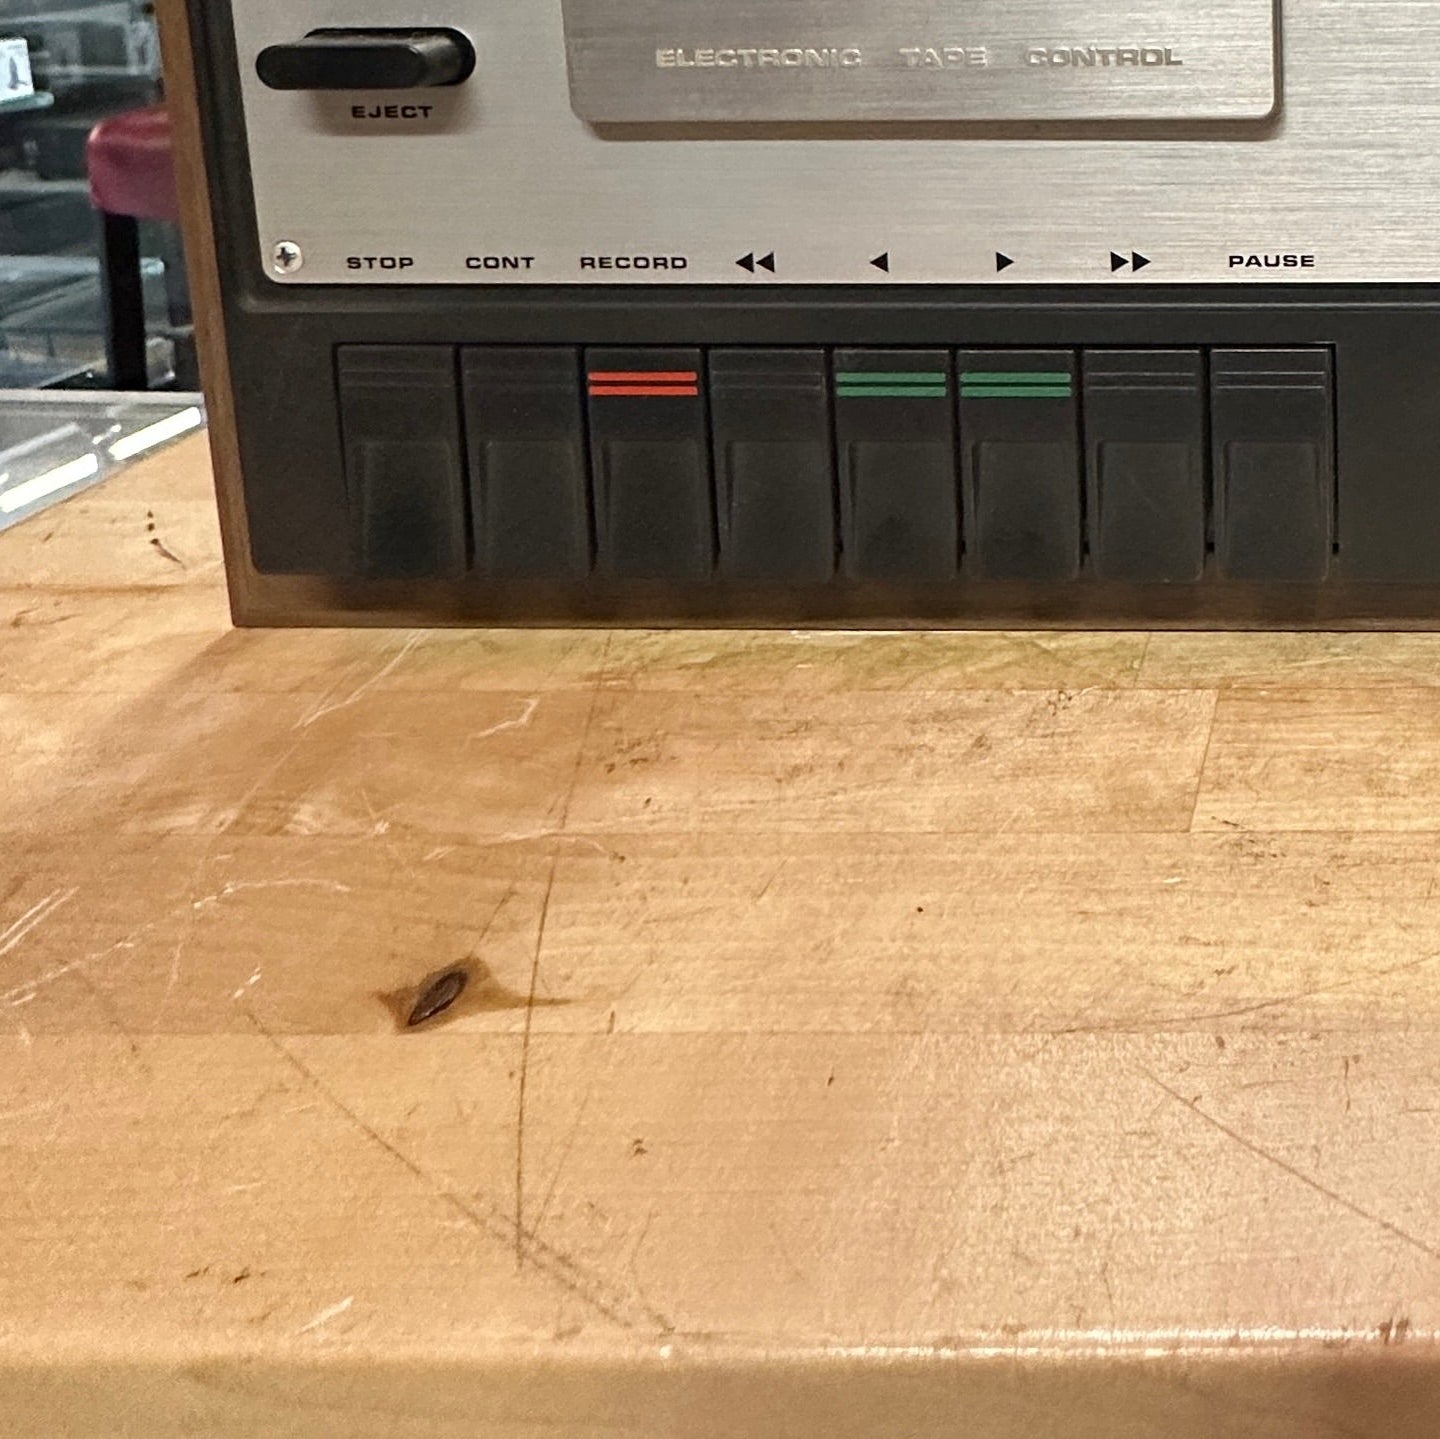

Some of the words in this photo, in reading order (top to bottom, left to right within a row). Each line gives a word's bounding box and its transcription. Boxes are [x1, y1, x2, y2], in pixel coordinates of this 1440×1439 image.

[655, 47, 862, 68] ELECTRONIC
[897, 47, 989, 67] TAPE
[1026, 47, 1183, 67] CONTROL
[352, 106, 432, 118] EJECT
[347, 257, 413, 269] STOP
[466, 257, 534, 269] CONT
[581, 257, 687, 269] RECORD
[1229, 255, 1314, 267] PAUSE
